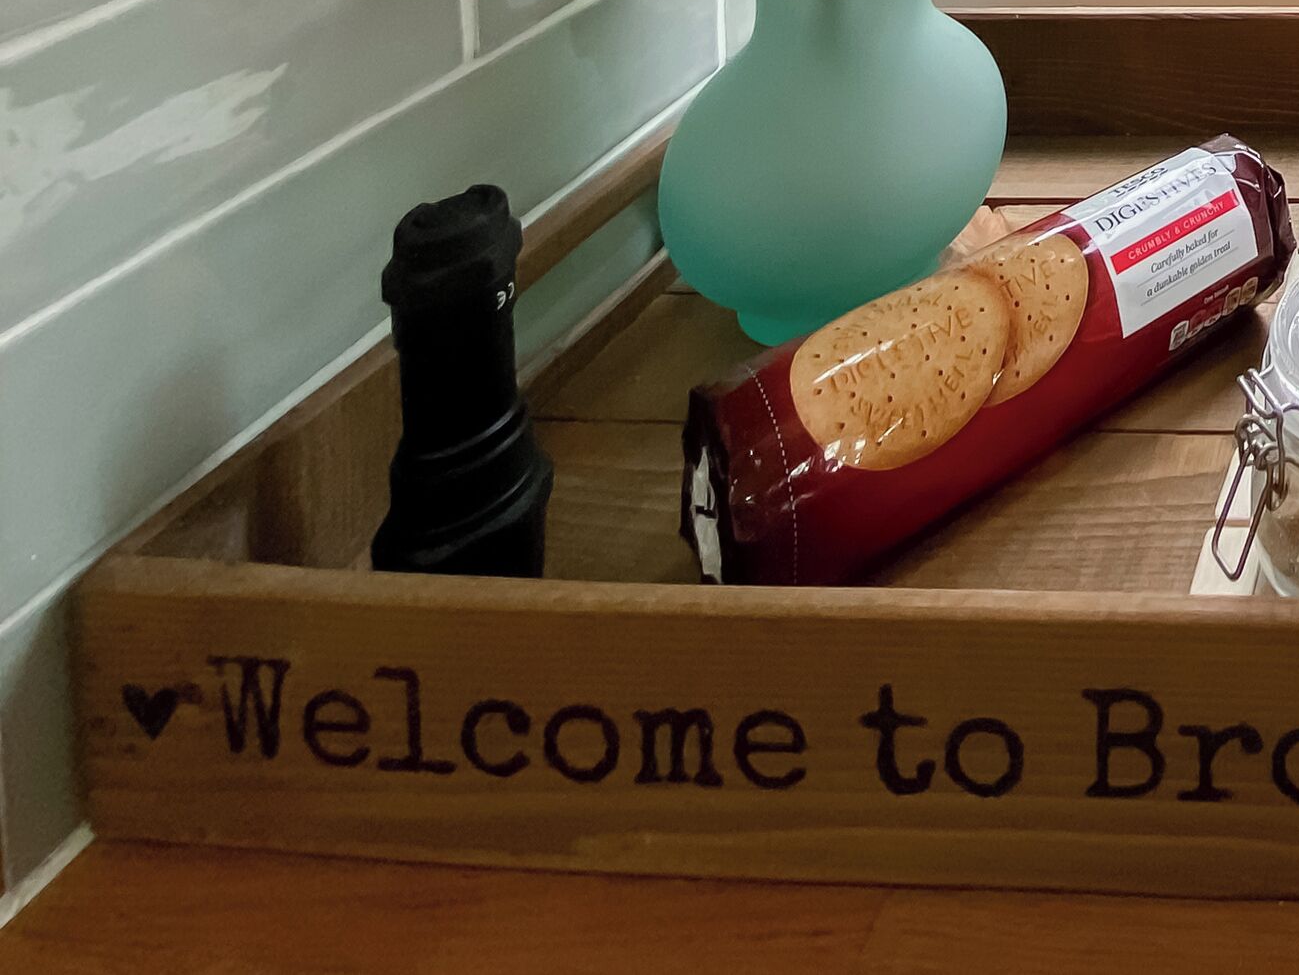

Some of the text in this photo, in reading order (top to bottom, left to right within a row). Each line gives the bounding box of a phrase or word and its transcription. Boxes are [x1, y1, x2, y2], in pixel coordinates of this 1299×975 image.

[1095, 162, 1217, 232] DIGESTIVES
[1128, 201, 1225, 260] CRUMBLY & CRUNCHY
[1150, 228, 1219, 274] Carefully baked for
[1146, 287, 1153, 297] a
[1153, 264, 1188, 293] dunkable
[1188, 251, 1214, 275] golden
[1213, 240, 1231, 261] treat
[209, 655, 808, 790] Welcome
[861, 683, 1024, 798] to
